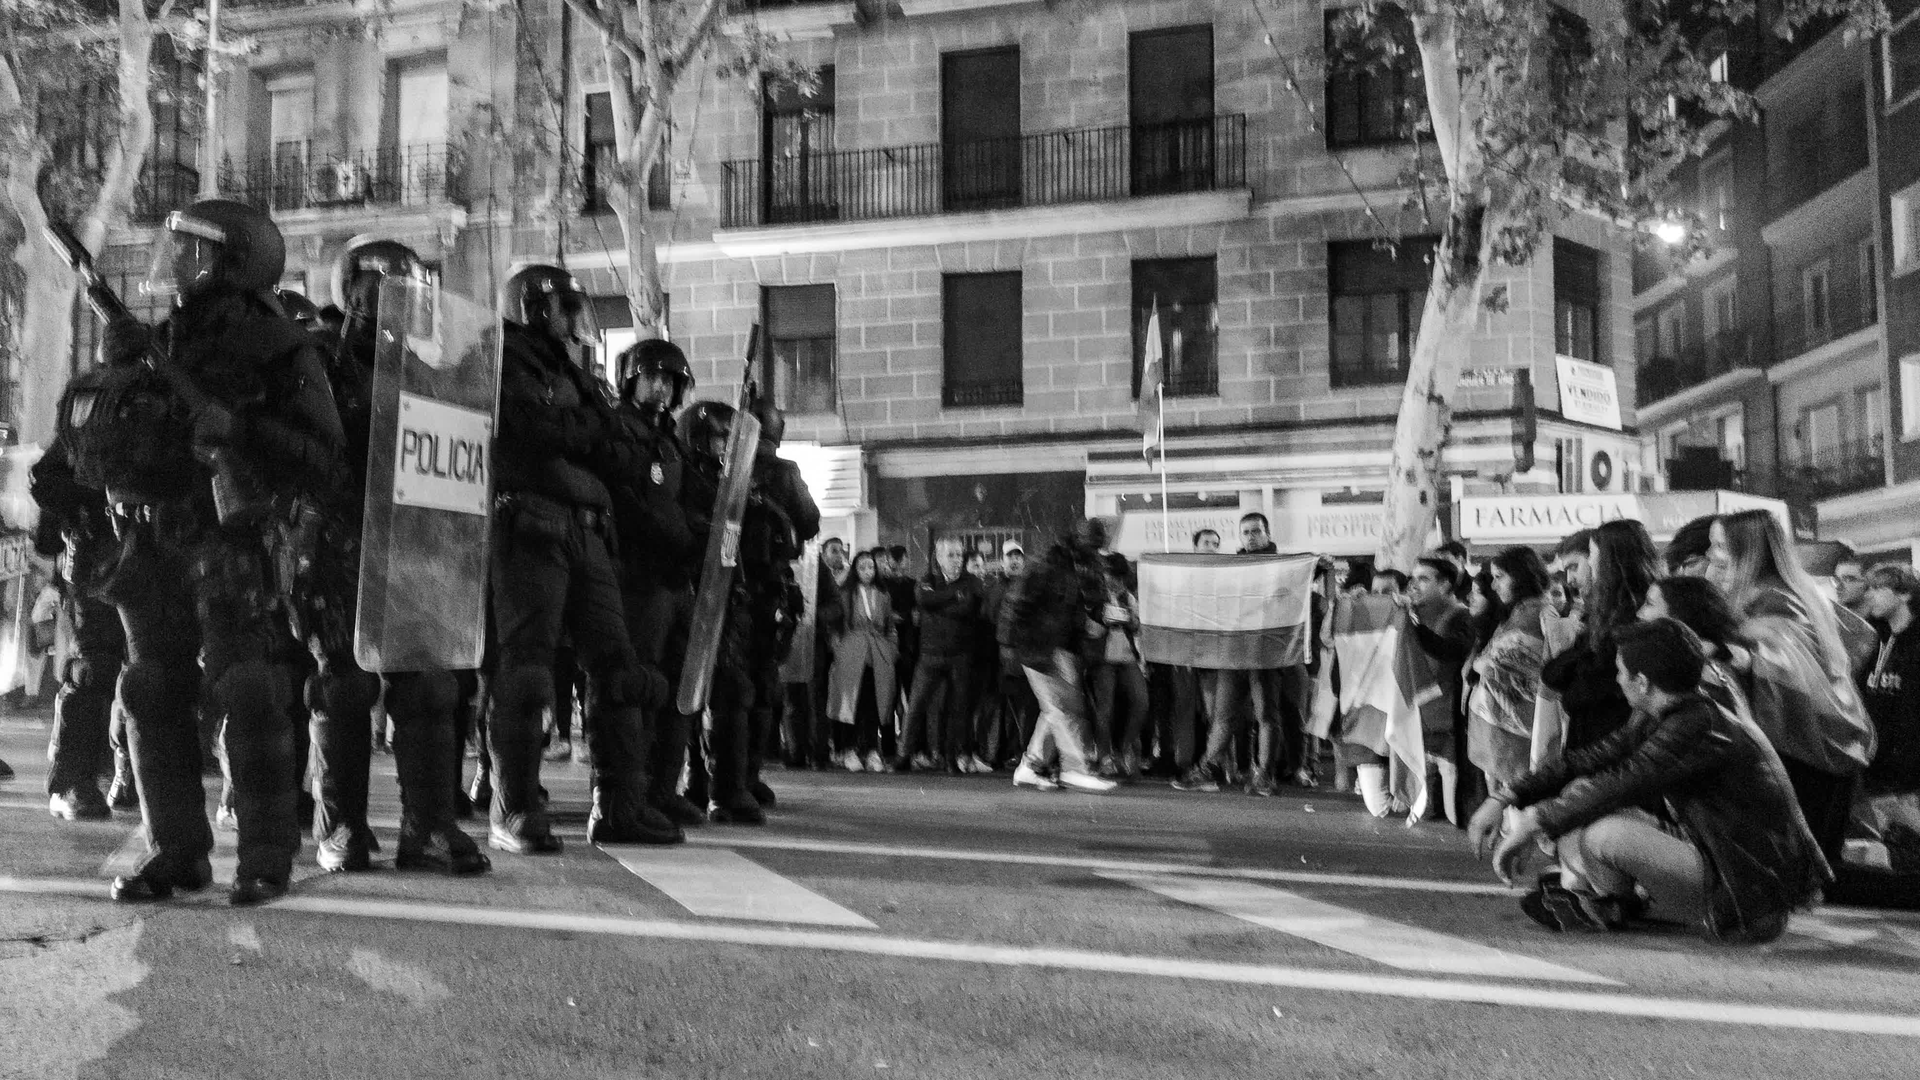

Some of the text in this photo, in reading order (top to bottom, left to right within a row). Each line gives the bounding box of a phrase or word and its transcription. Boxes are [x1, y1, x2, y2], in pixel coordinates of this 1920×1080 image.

[1566, 383, 1612, 406] VENDIDO
[400, 428, 485, 486] POLICIA
[1474, 503, 1625, 528] FARMACIA
